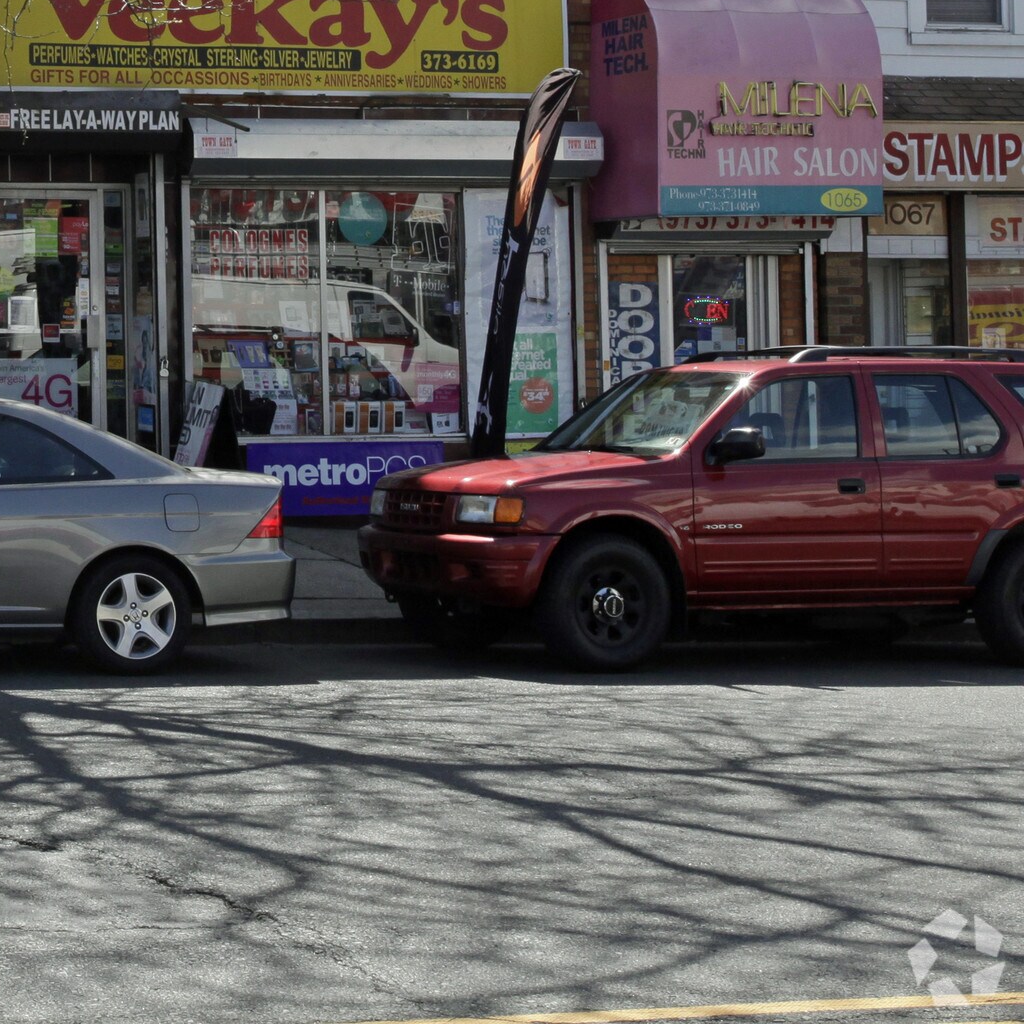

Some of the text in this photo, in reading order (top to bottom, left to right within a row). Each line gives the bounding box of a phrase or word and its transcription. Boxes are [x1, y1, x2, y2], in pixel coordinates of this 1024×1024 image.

[602, 14, 648, 38] MILENA
[605, 32, 644, 55] HAIR
[33, 47, 354, 69] PERFUMES WATCHES CRYSTAL STERLING SILVER JEWELRY
[423, 53, 496, 71] 373-6169
[30, 69, 507, 90] GIFTS FOR ALL OCCASSIONS BIRTHDAYS ANNIVERSARIES WEDDINGS SHOWERS
[718, 81, 878, 118] MILENA
[10, 108, 51, 130] FREE
[53, 109, 138, 131] LAY-A-WAY
[139, 110, 179, 131] PLAN
[667, 148, 706, 160] TECHNI
[717, 147, 878, 177] HAIR SALON
[883, 131, 1024, 181] STAMP
[827, 192, 863, 208] 1065
[884, 203, 936, 226] 1067
[990, 216, 1024, 242] ST
[209, 229, 309, 253] COLOGNES
[209, 256, 309, 279] PERFUMES
[21, 373, 73, 408] 4G
